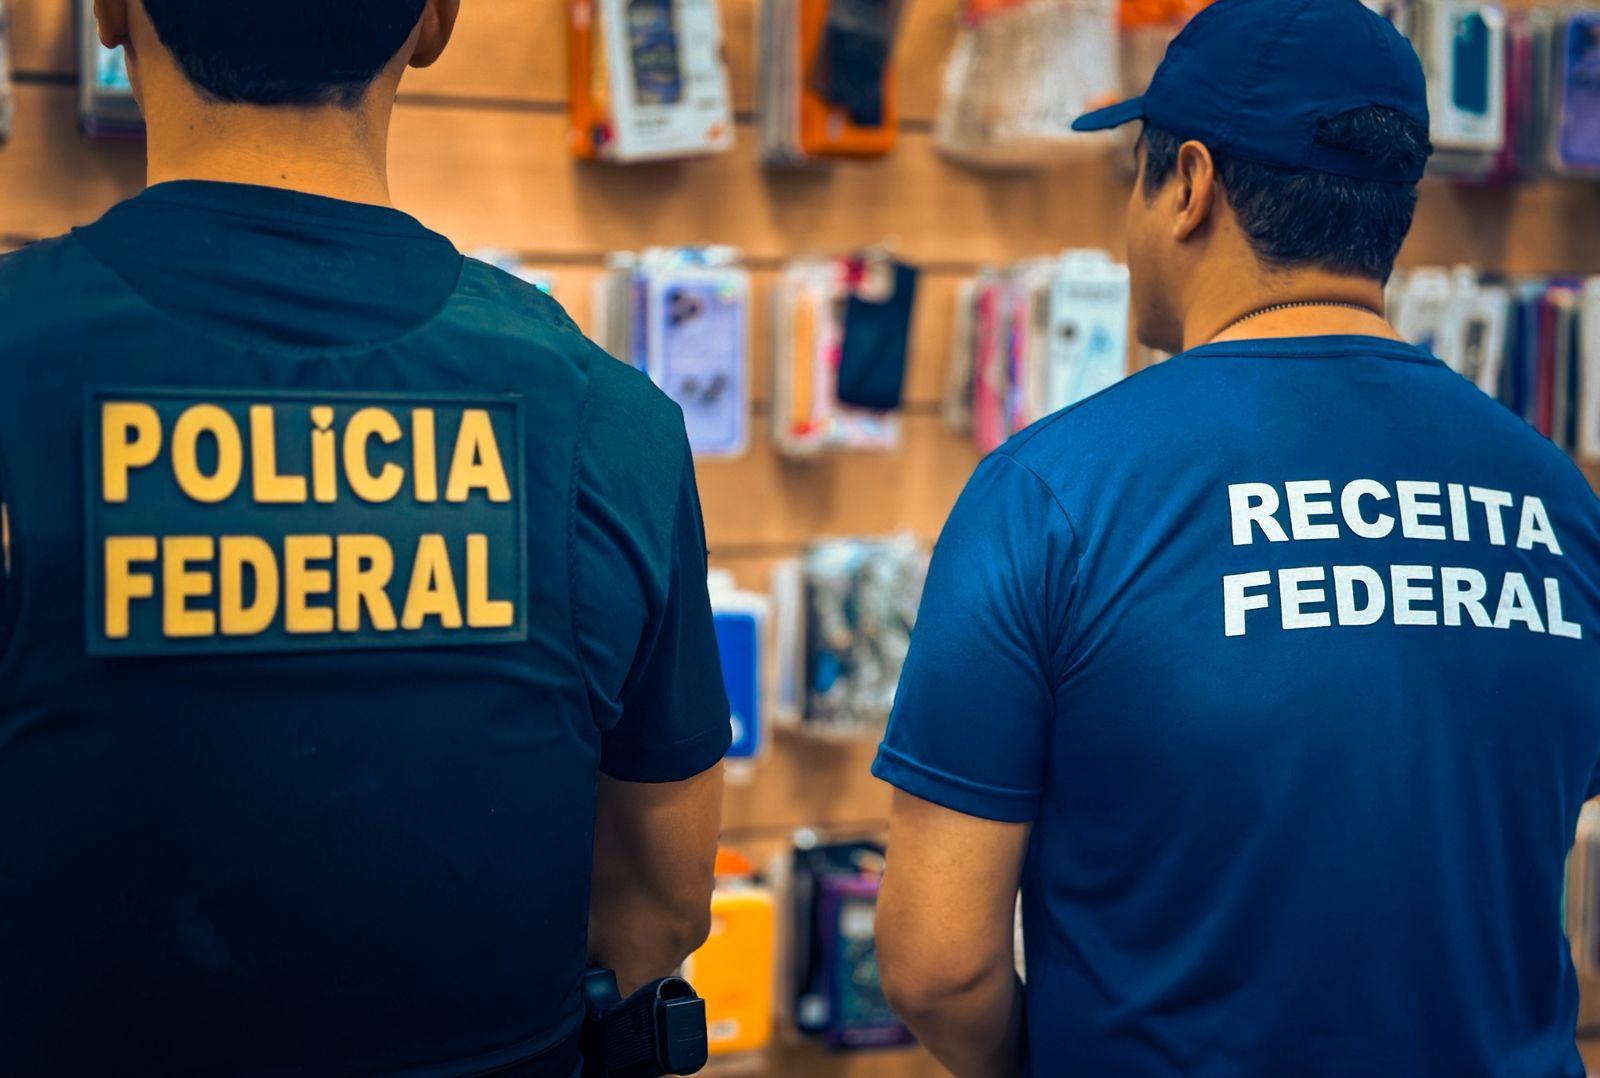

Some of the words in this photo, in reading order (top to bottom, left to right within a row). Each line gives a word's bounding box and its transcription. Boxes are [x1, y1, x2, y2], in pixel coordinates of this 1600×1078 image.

[1228, 478, 1563, 555] RECEITA
[104, 534, 514, 638] FEDERAL
[1223, 564, 1582, 639] FEDERAL
